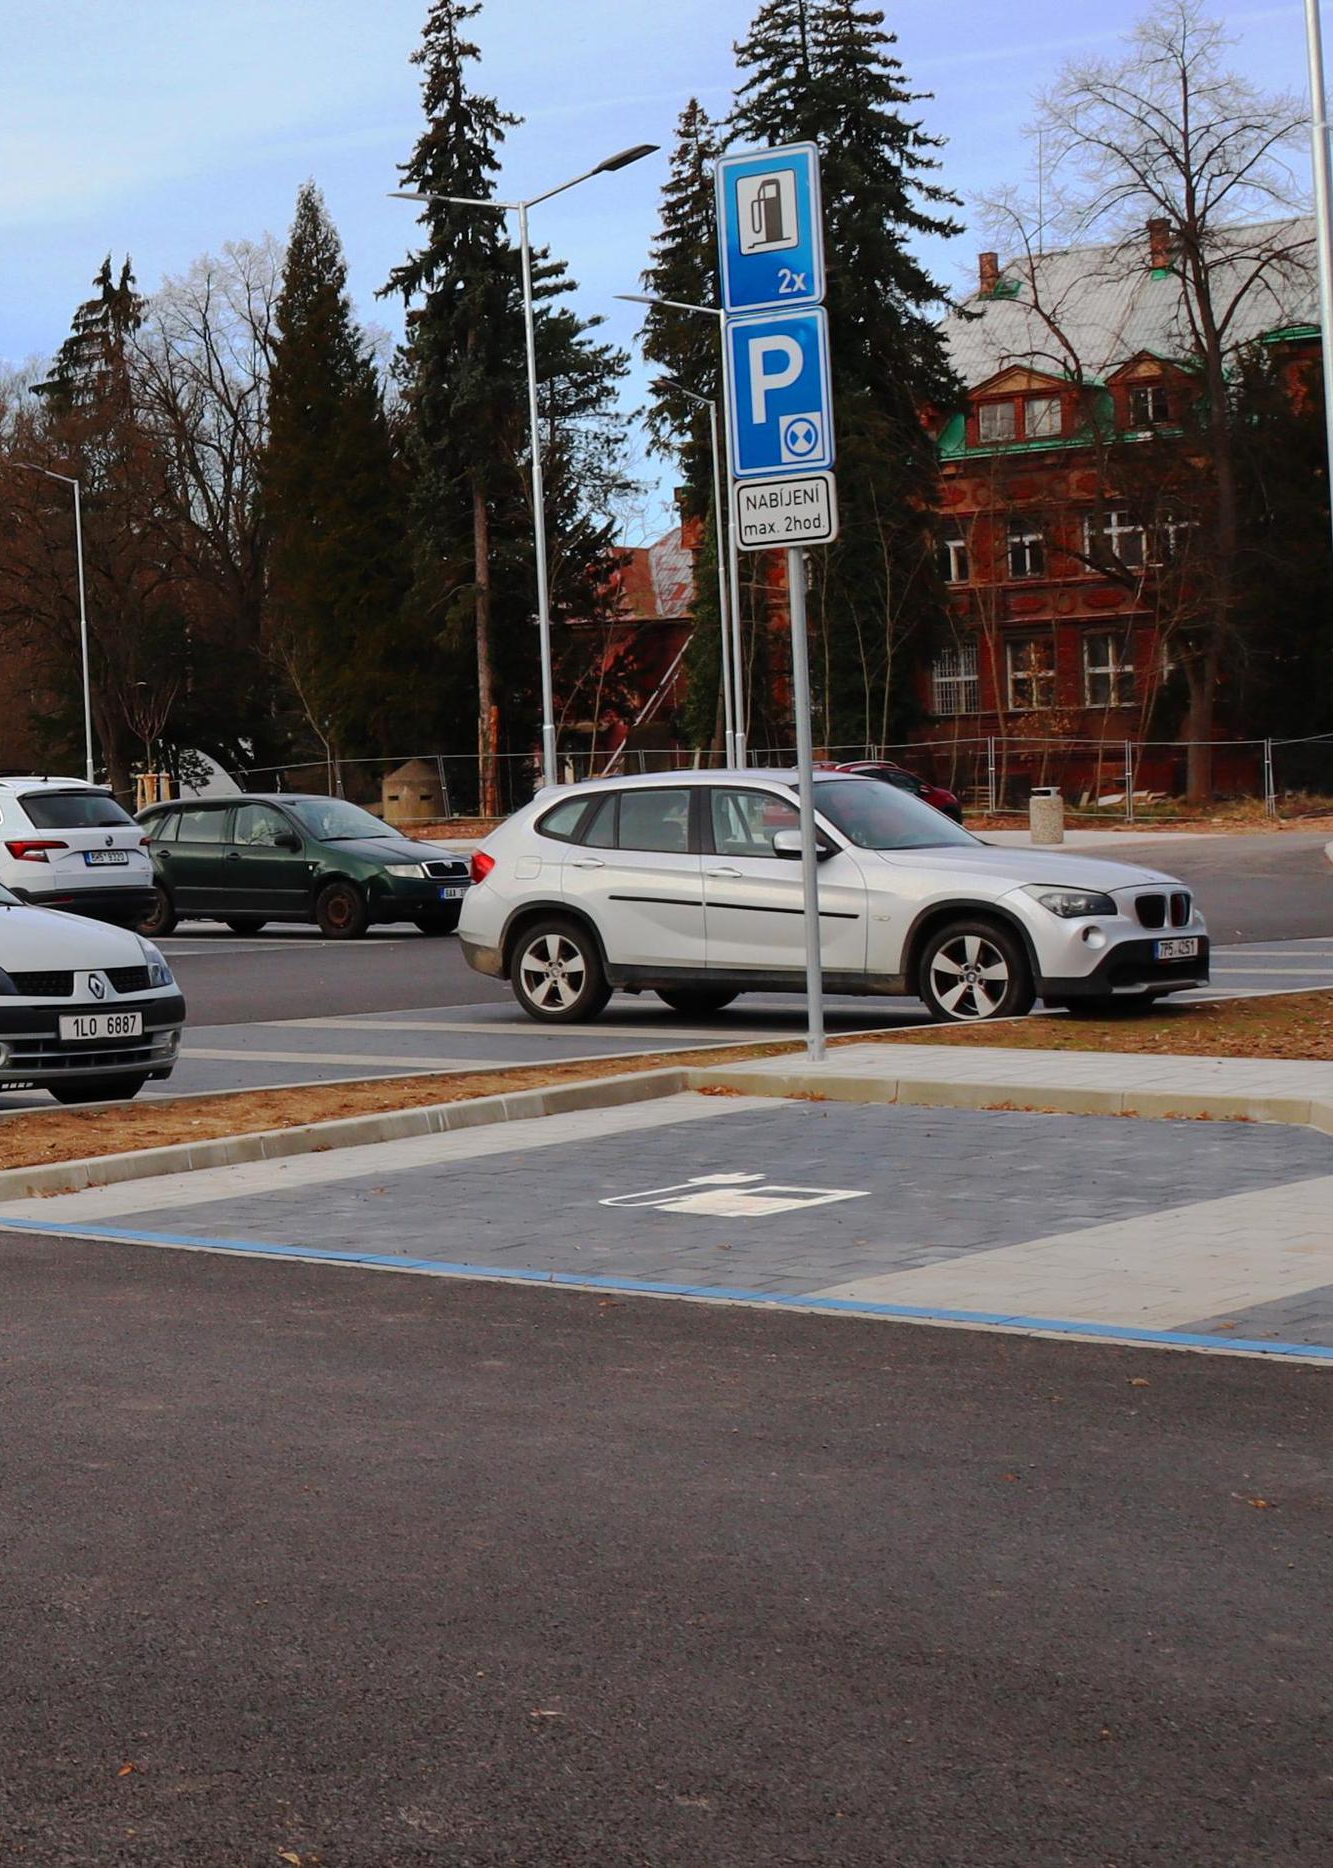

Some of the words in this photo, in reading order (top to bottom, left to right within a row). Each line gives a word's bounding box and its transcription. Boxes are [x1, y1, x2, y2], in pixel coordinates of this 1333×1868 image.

[777, 268, 807, 294] 2x
[748, 334, 804, 425] P
[746, 483, 820, 511] NABÍJENÍ
[744, 521, 780, 537] max.
[784, 513, 826, 532] 2hod.
[107, 1014, 136, 1034] 6887
